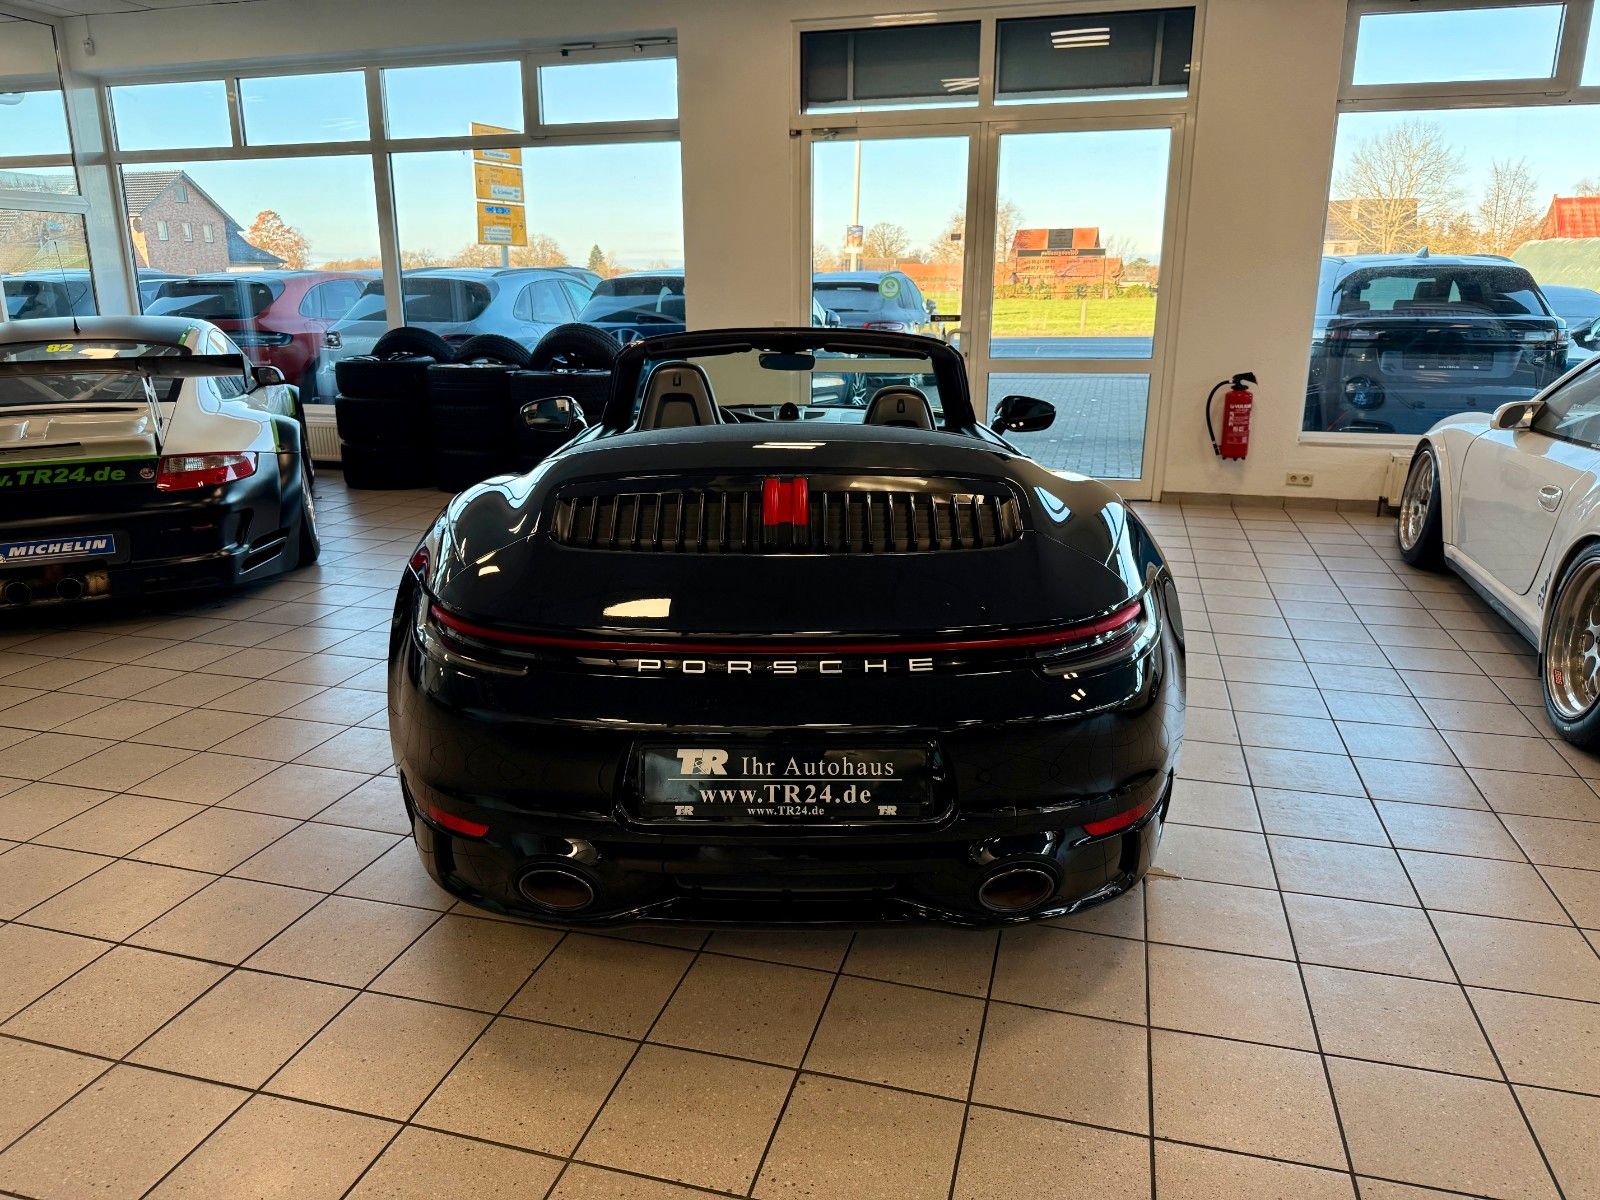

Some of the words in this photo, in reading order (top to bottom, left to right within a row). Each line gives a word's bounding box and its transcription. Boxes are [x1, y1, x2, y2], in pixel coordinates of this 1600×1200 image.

[46, 343, 73, 353] 82
[8, 539, 107, 557] MICHELIN
[637, 657, 934, 674] PORSCHE
[742, 756, 776, 776] Ihr
[784, 756, 894, 776] Autohaus
[698, 784, 872, 804] www.TR24.de
[747, 805, 825, 817] www.TR24.de
